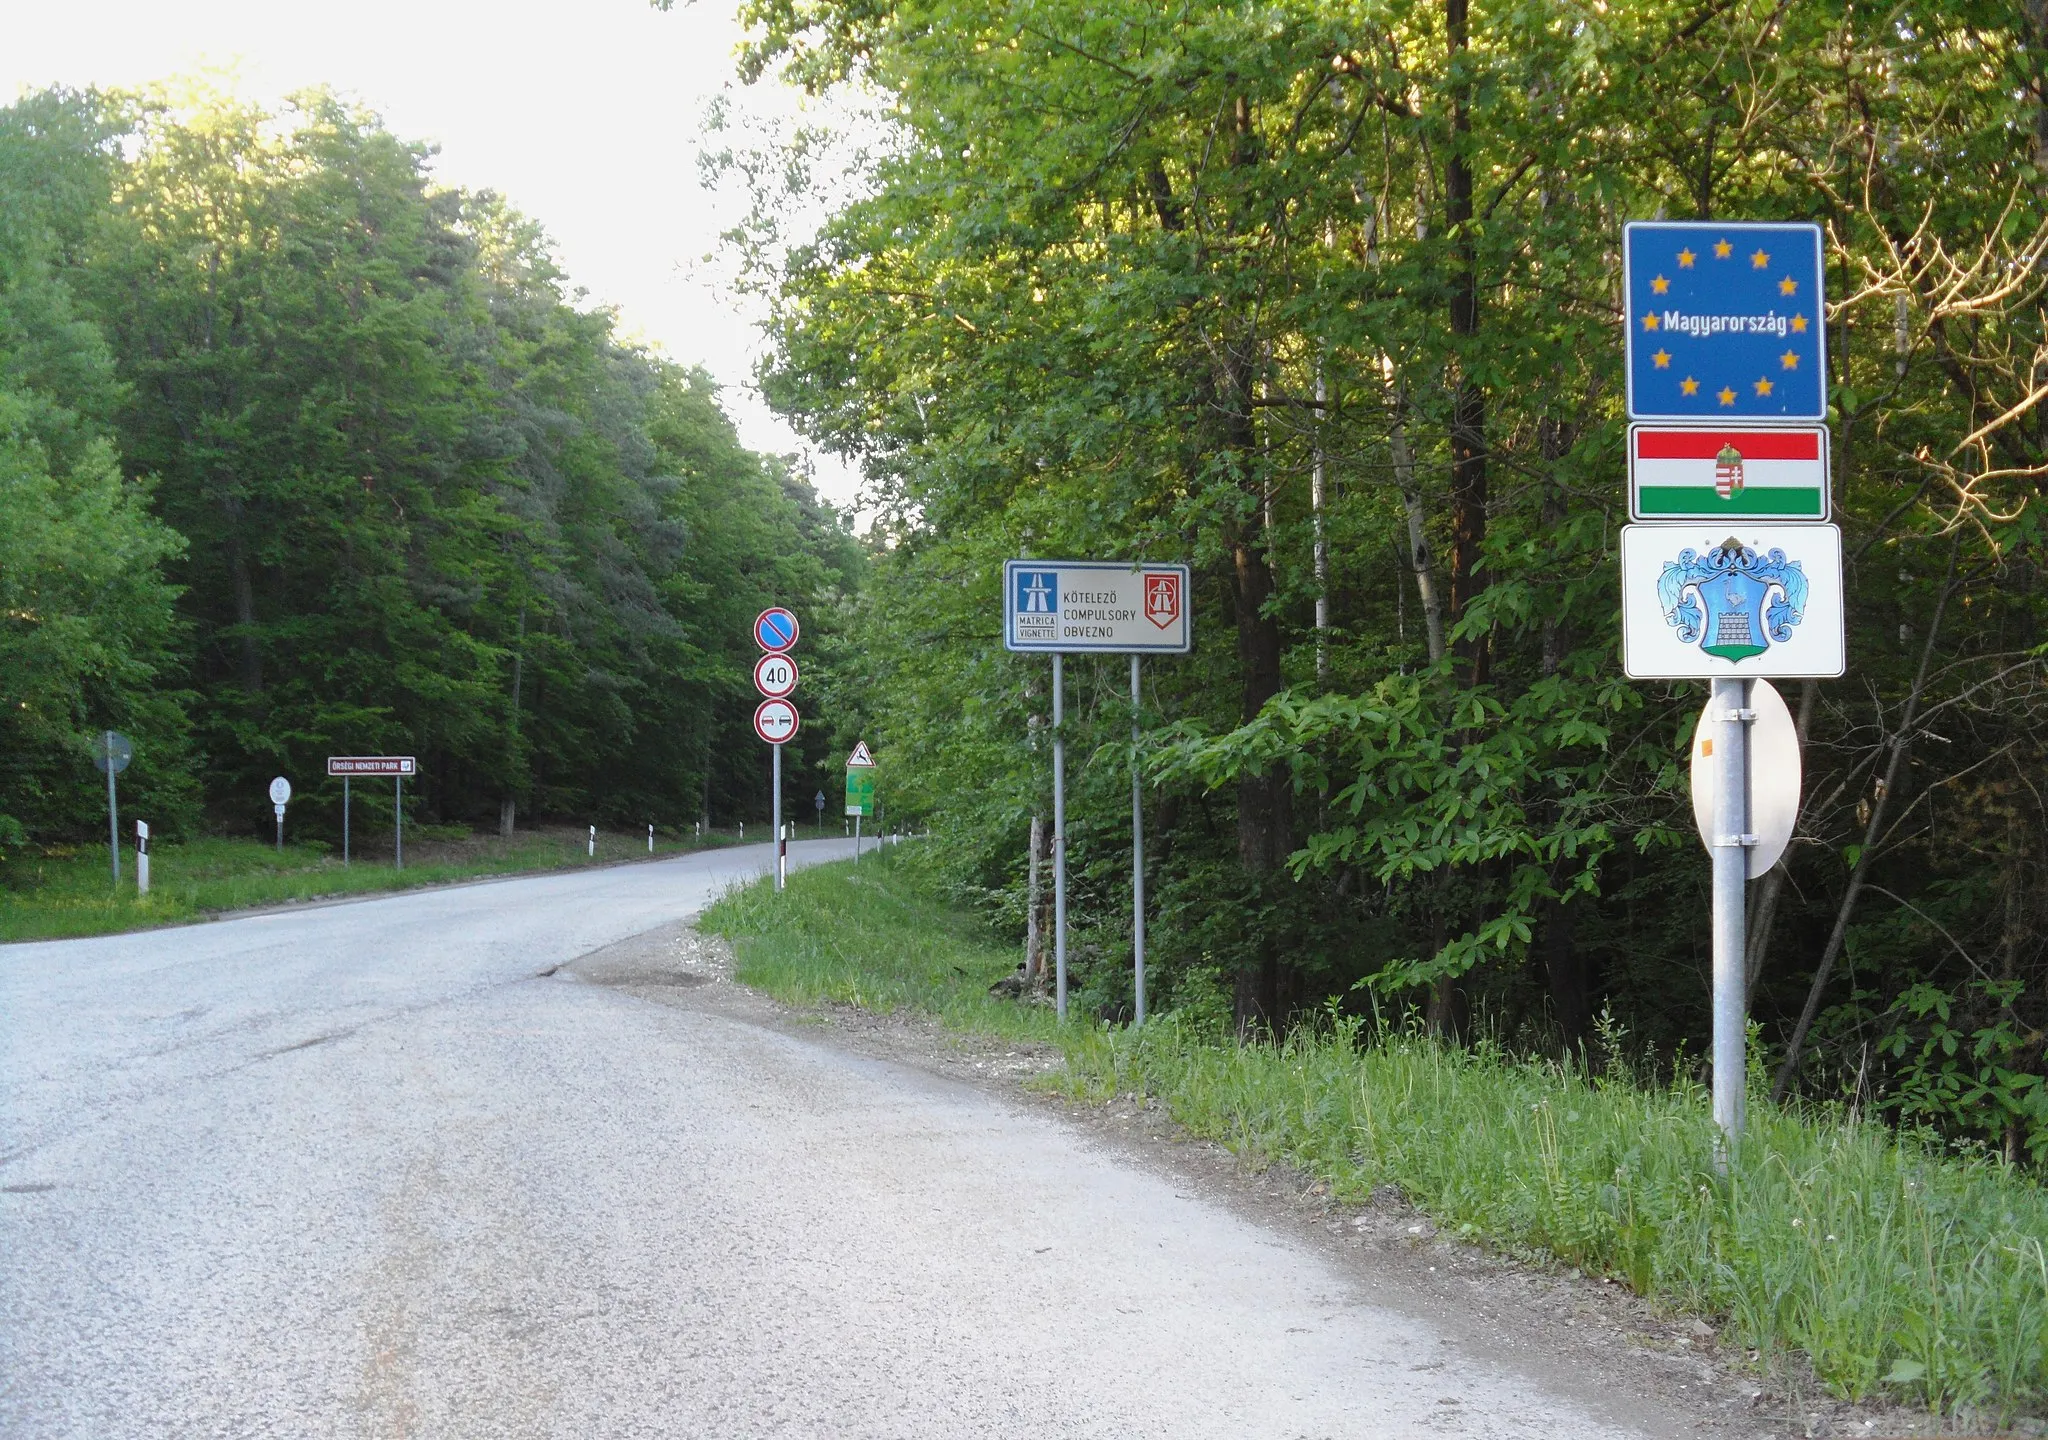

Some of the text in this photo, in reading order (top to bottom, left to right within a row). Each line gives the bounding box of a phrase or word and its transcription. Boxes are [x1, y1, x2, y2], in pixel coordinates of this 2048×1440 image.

[1664, 309, 1787, 338] Magyarország
[1019, 616, 1055, 625] MATRICA
[1063, 609, 1137, 621] COMPULSORY
[1019, 629, 1055, 638] VIGNETTE
[1063, 626, 1113, 638] OBVEZNO
[766, 667, 787, 684] 40
[381, 761, 398, 770] PARK
